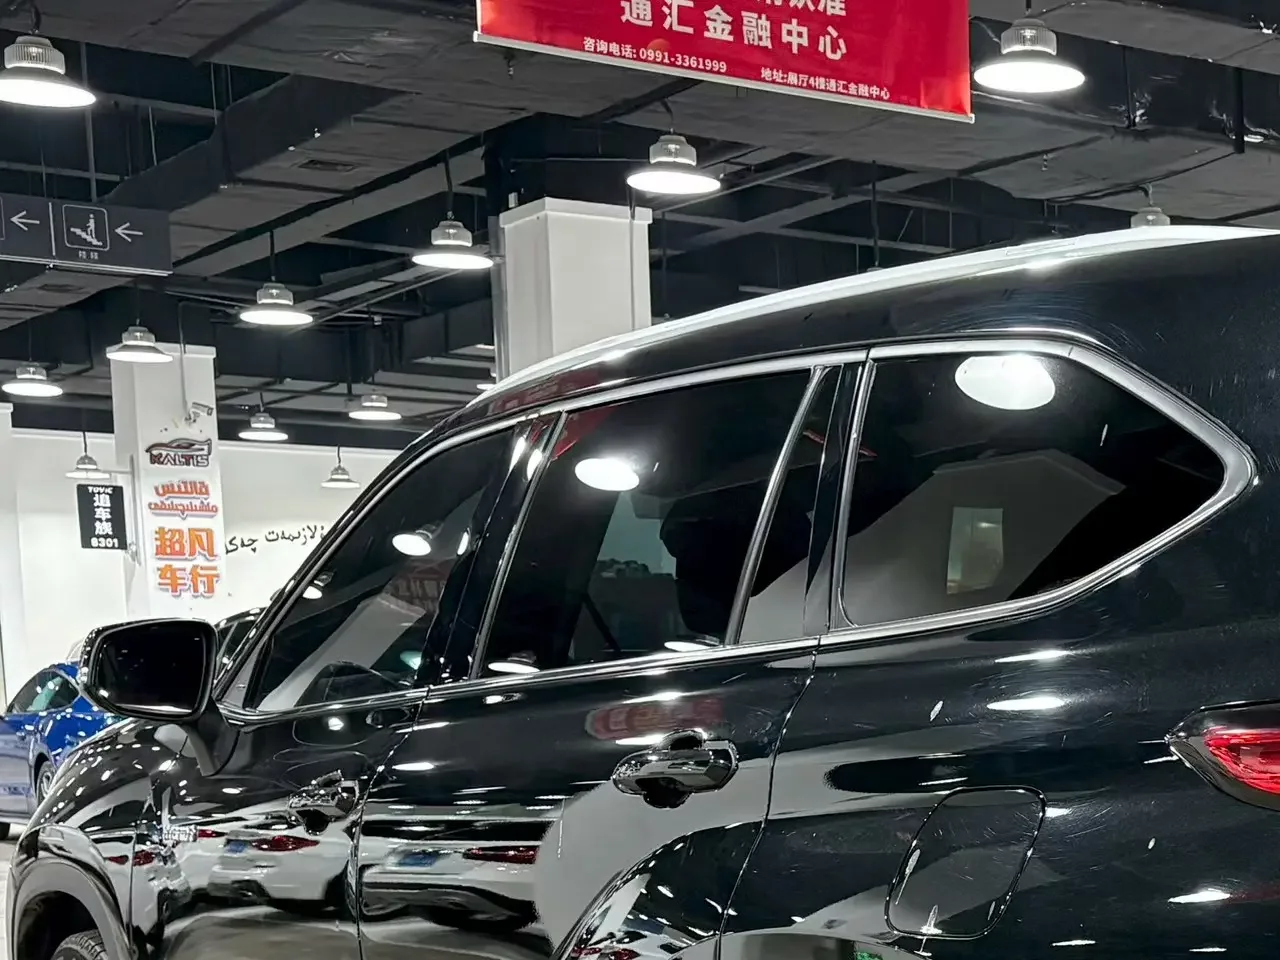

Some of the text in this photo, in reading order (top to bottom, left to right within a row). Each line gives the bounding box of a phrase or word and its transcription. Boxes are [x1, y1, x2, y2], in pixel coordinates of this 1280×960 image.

[620, 0, 847, 61] 通汇金融中心
[583, 37, 727, 73] 咨询电话: 0991-3361999
[149, 452, 210, 468] KALTIS
[154, 527, 217, 560] 超凡
[157, 564, 220, 595] 车行
